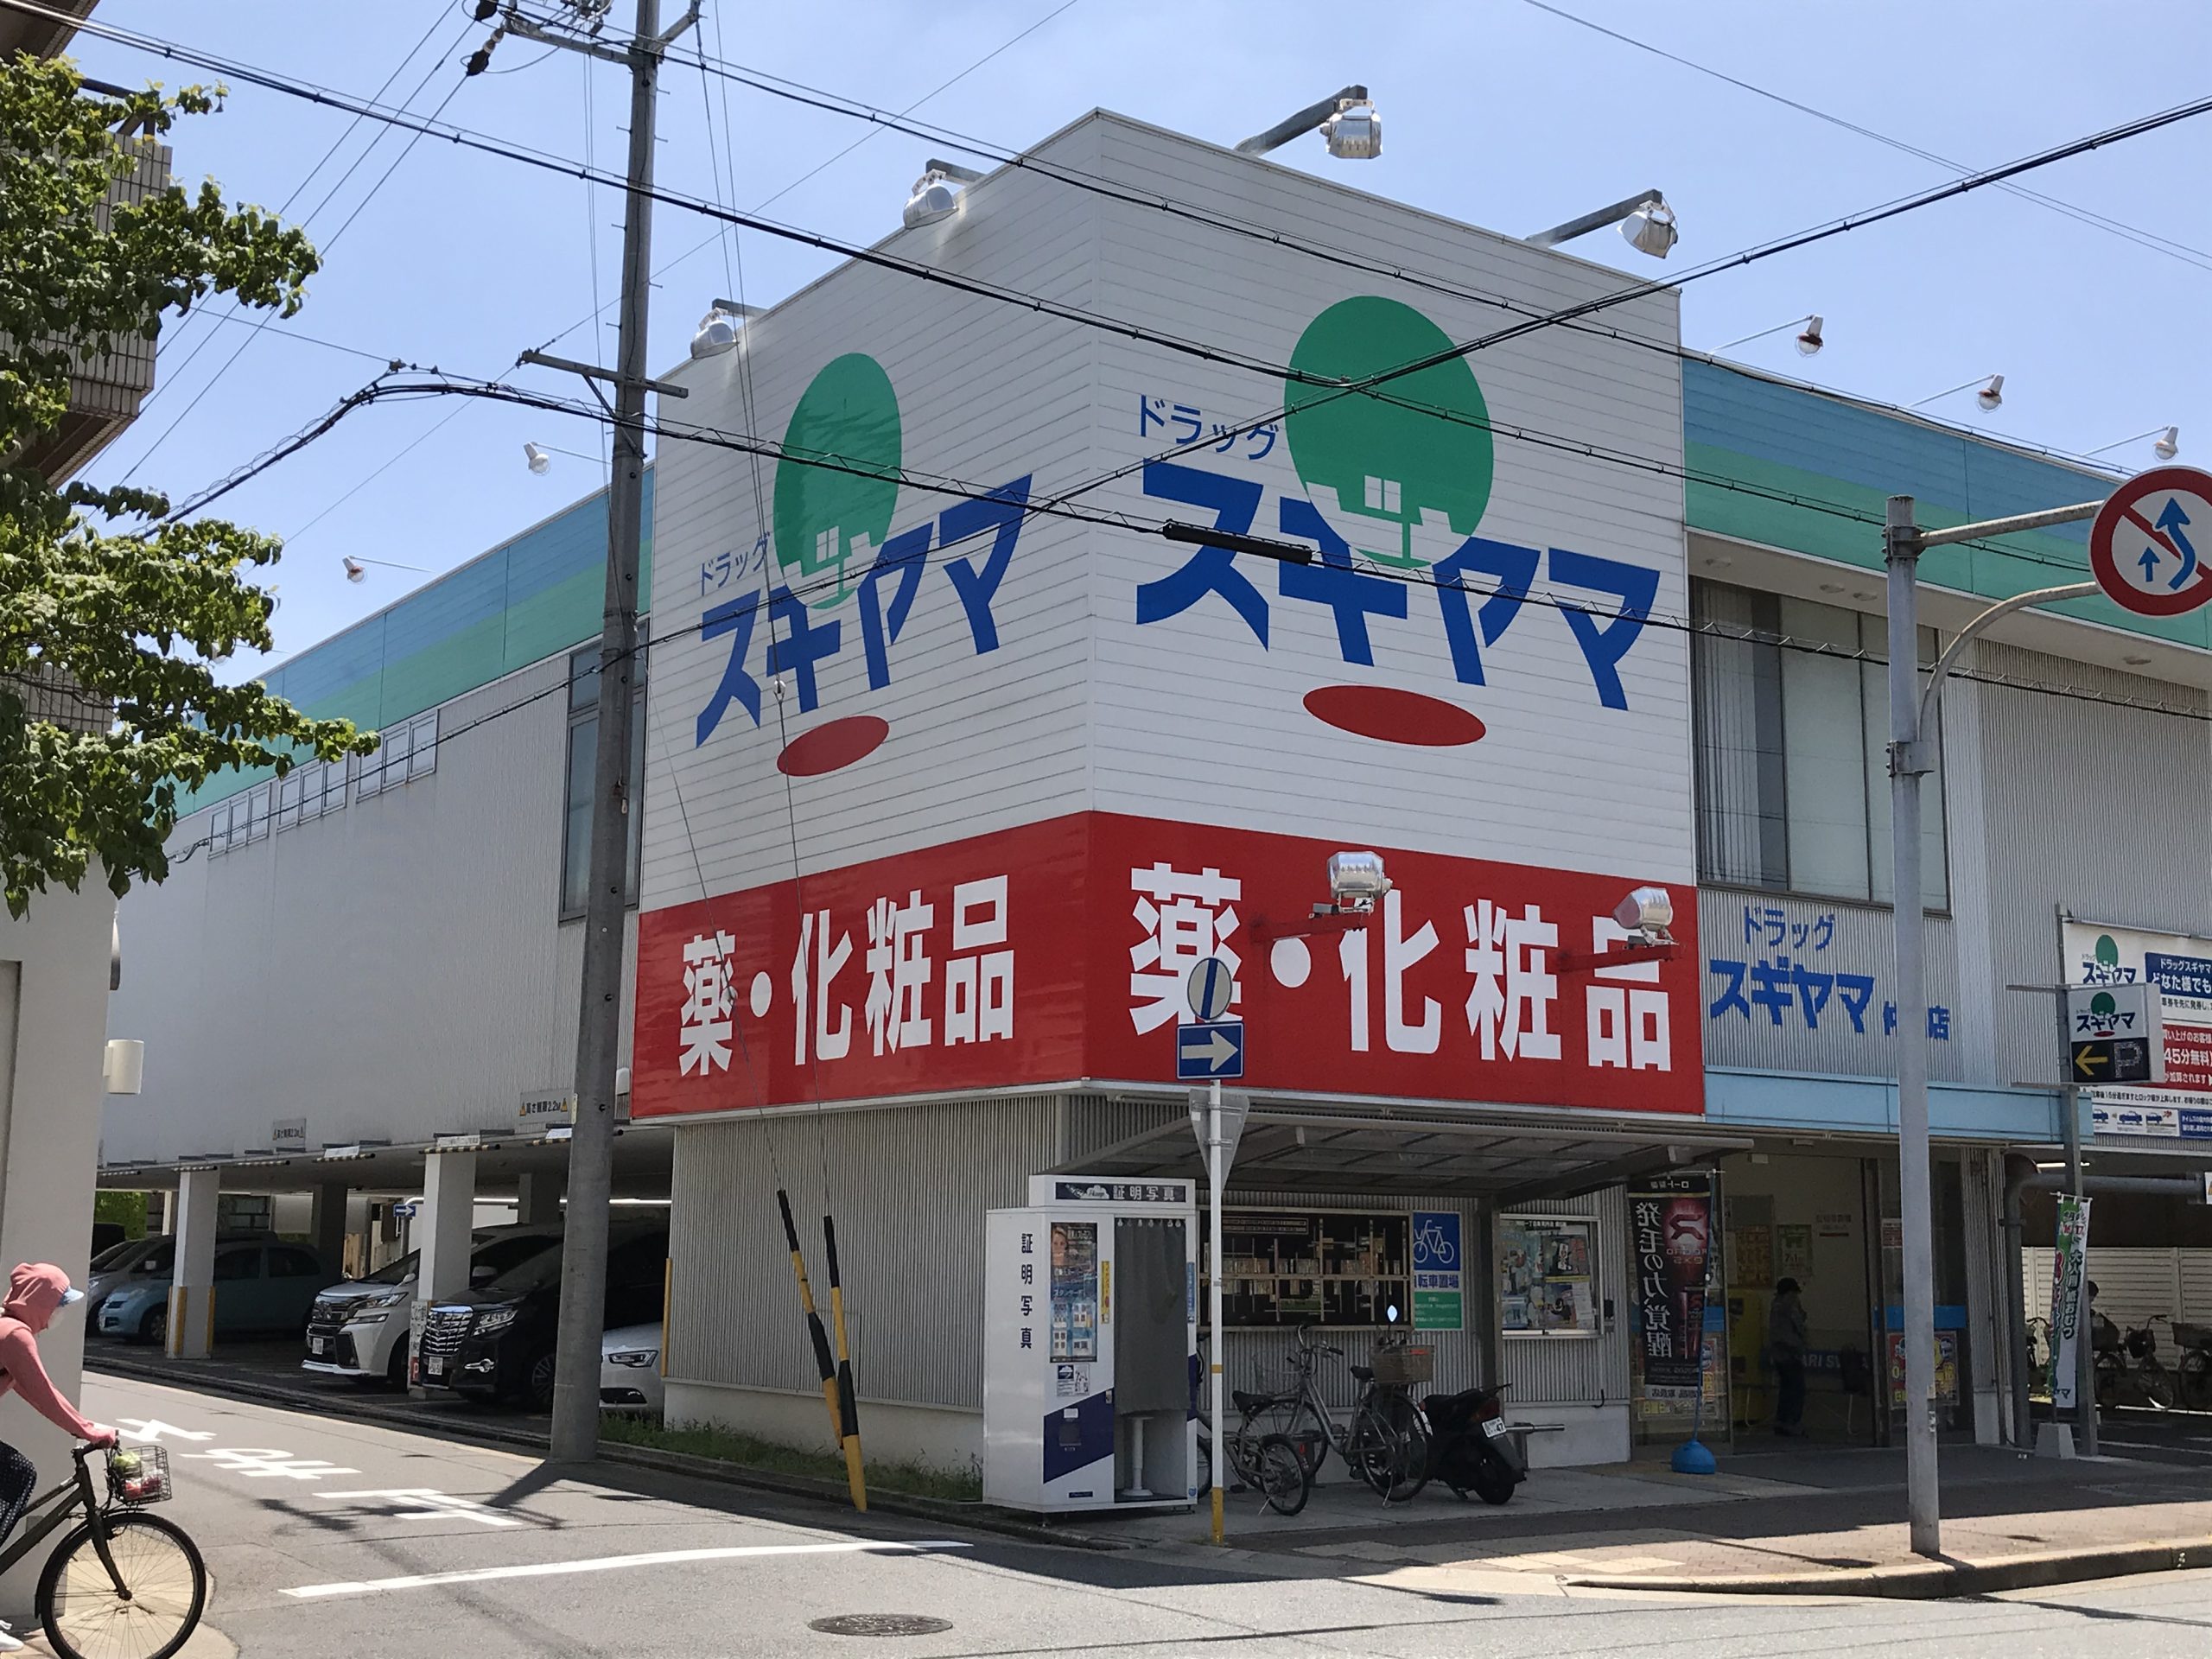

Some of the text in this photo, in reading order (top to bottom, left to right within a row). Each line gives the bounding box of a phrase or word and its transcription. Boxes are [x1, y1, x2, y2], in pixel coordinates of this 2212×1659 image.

[1139, 393, 1281, 461] ドラッグ
[701, 531, 772, 596] ドラッグ
[1745, 905, 1835, 950] ドラッグ
[679, 874, 1014, 1077] 薬・化粧品
[1709, 956, 1875, 1034] スギヤマ
[2160, 958, 2211, 974] ドラッグスギヤマ
[1112, 1185, 1175, 1201] 証明写真
[1020, 1233, 1033, 1350] 証明写真
[1414, 1274, 1459, 1288] 転車置場
